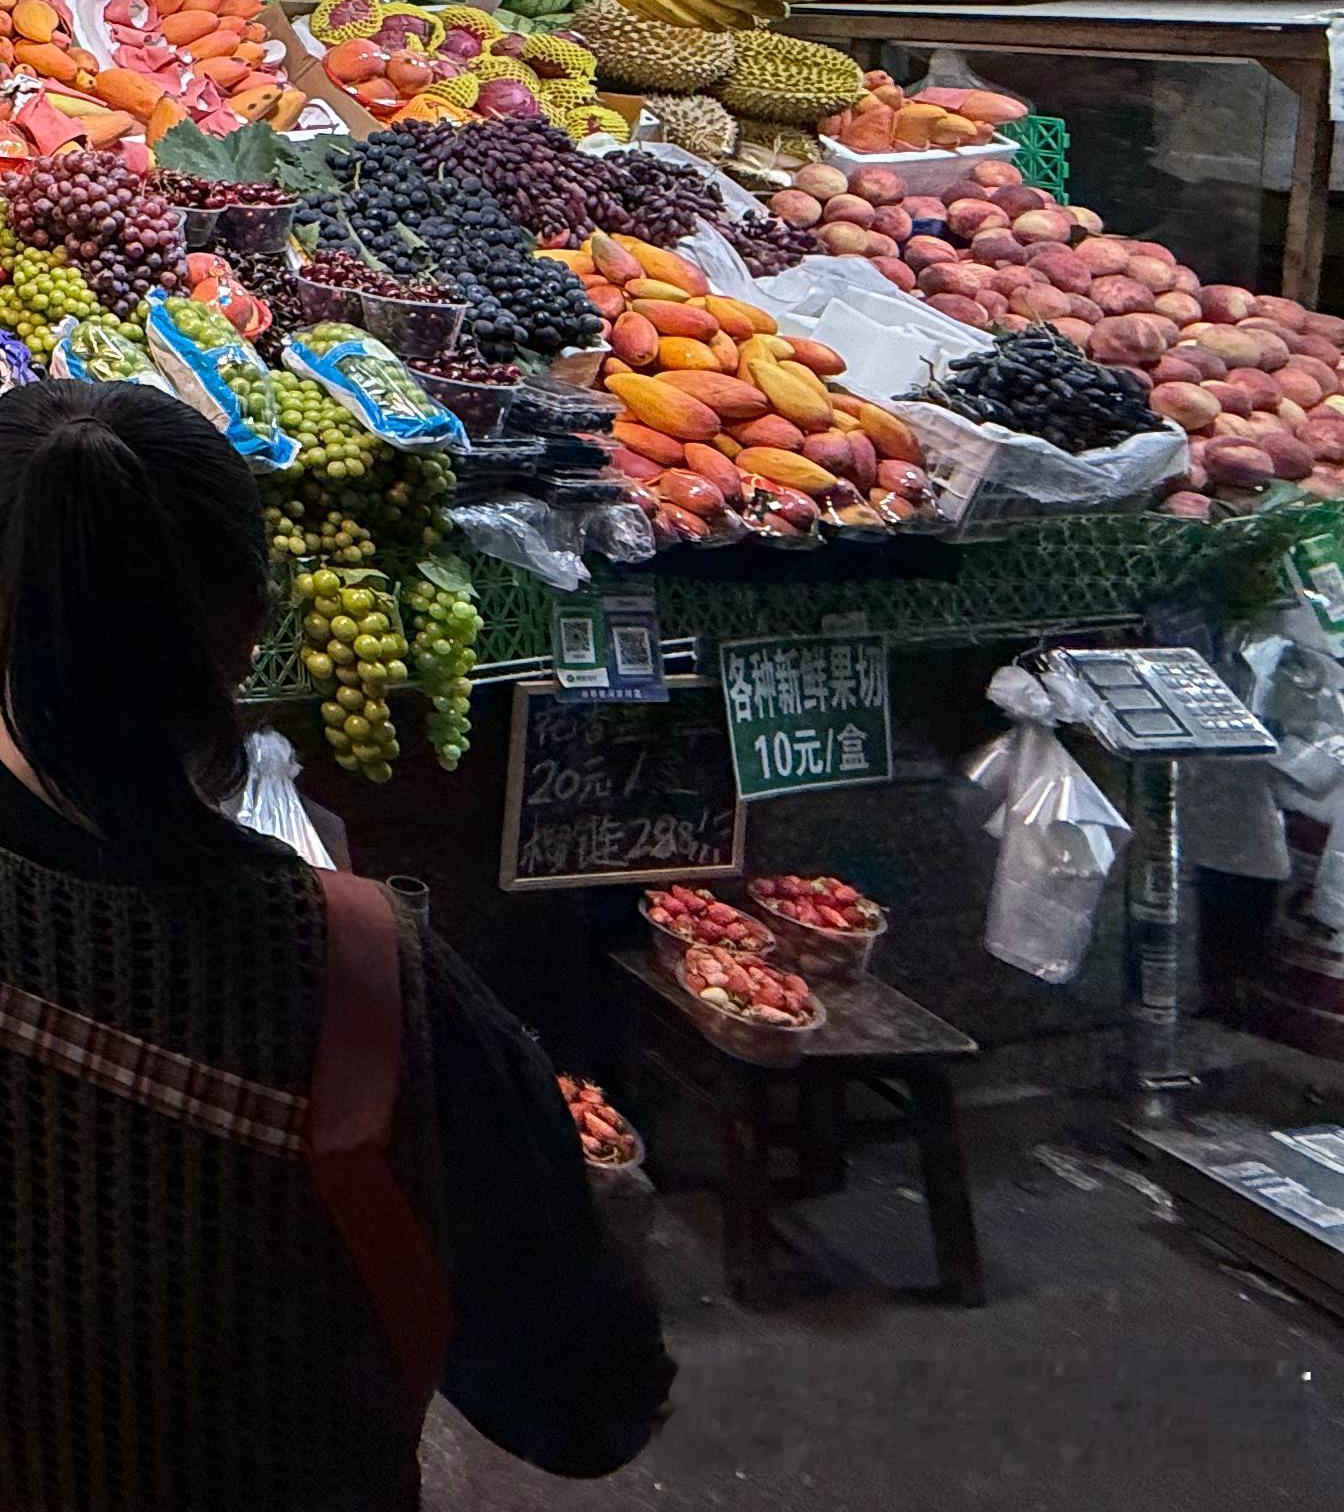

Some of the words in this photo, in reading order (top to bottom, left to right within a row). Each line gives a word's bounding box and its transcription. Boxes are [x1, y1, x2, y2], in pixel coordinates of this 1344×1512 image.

[729, 644, 888, 723] 各种新鲜果切
[754, 722, 870, 780] 10元/盒
